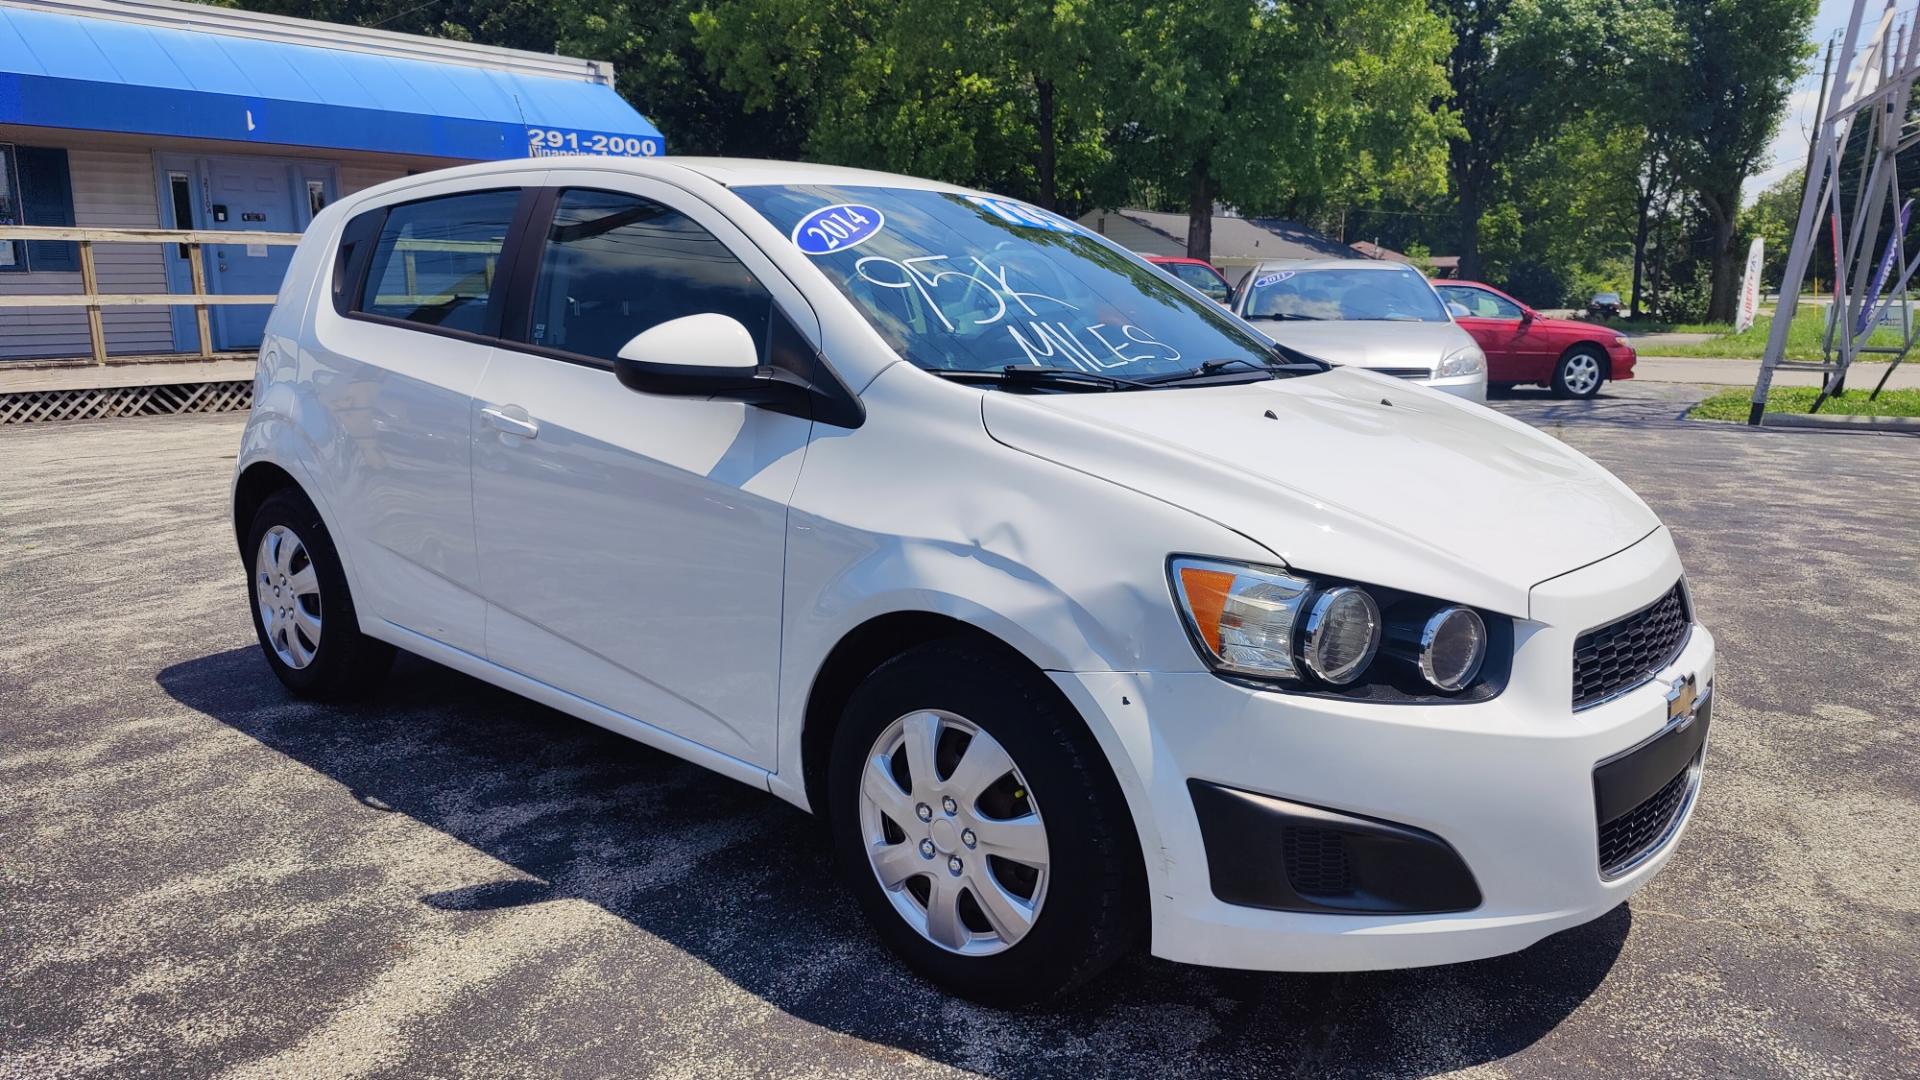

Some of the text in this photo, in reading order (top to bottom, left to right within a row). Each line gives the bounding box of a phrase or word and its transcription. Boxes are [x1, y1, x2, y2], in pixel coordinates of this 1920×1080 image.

[528, 129, 657, 156] 291-2000
[807, 206, 870, 250] 2014
[855, 254, 1080, 333] 95K
[1007, 321, 1181, 373] MILES
